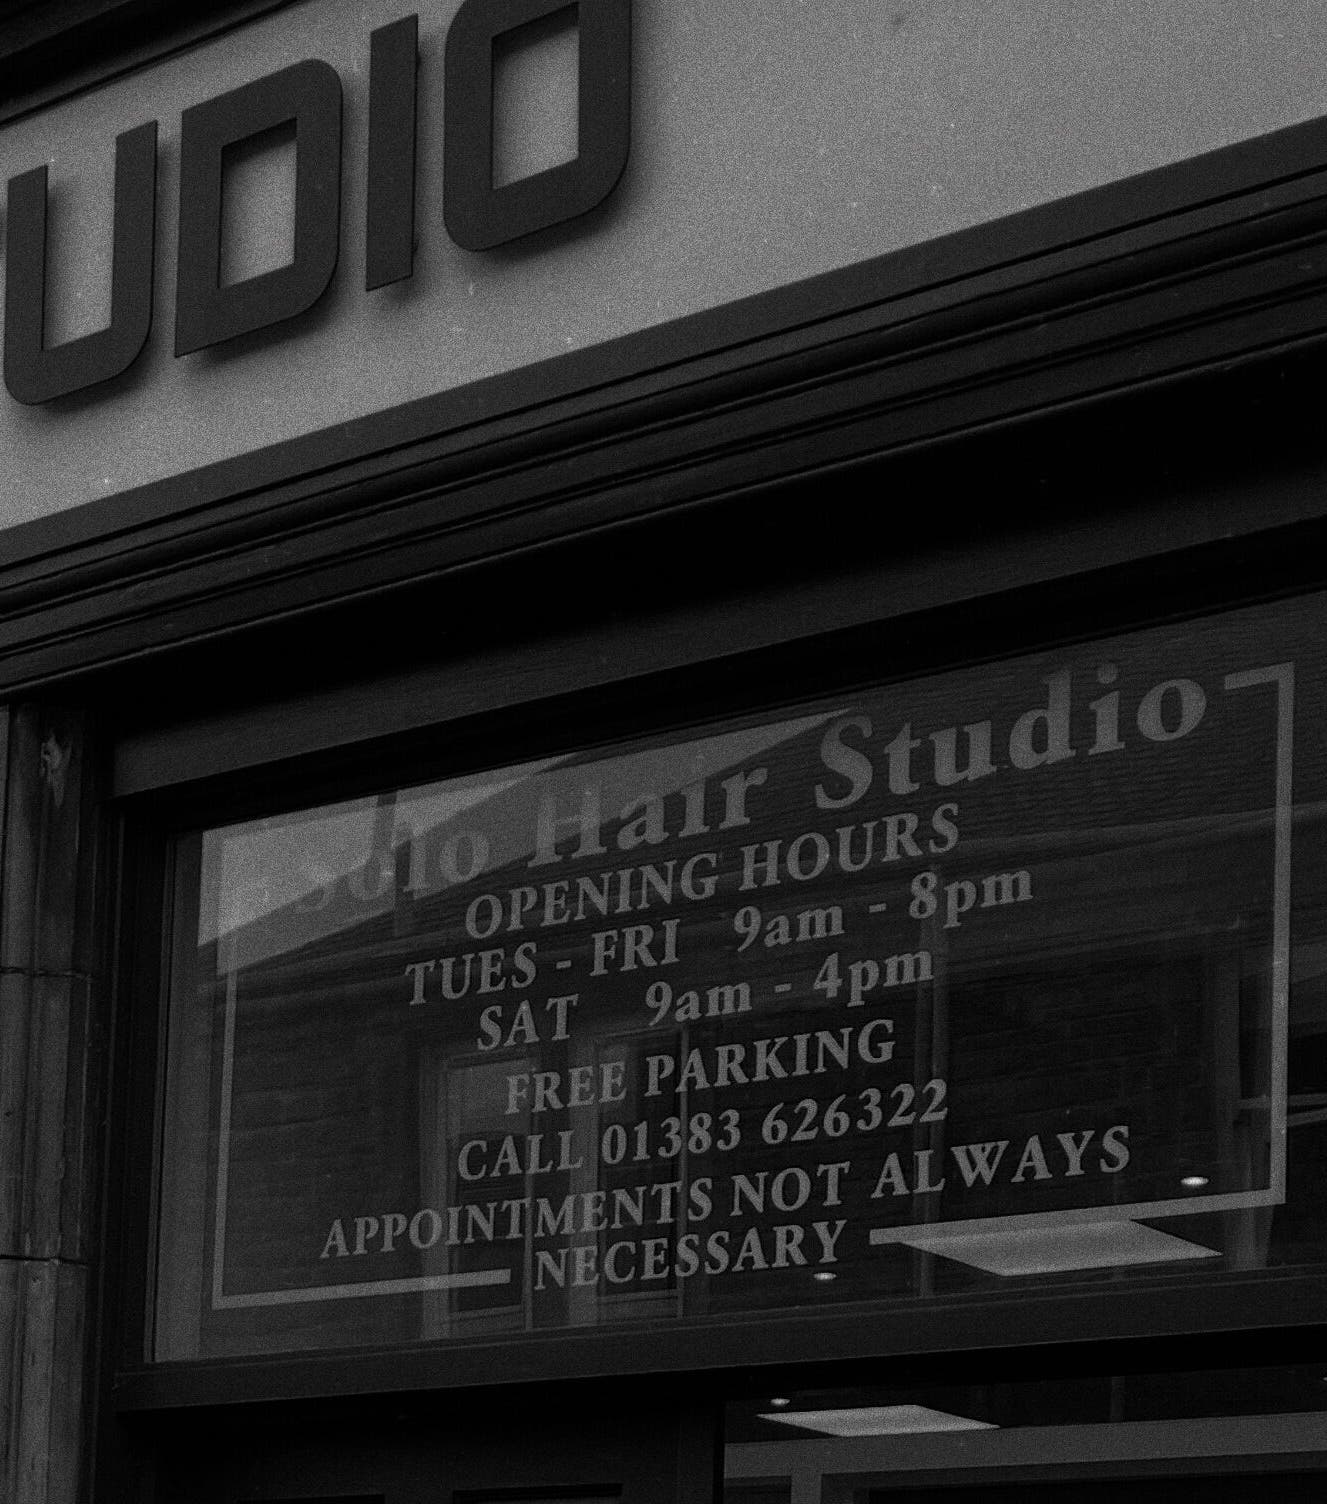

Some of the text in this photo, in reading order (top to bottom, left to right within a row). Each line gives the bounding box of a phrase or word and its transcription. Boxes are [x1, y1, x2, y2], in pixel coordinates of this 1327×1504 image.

[527, 748, 768, 868] Hair
[814, 662, 1208, 810] Studio
[465, 802, 960, 939] OPENING HOURS
[405, 867, 1034, 1006] TUES - FRI 9am - 8pm
[476, 950, 934, 1051] SAT 9am - 4pm
[504, 1018, 896, 1115] FREE PARKING
[457, 1078, 949, 1181] CALL 01383 626322
[319, 1125, 1131, 1259] APPOINTMENTS NOT ALWAYS
[533, 1219, 848, 1291] NECESSARY
